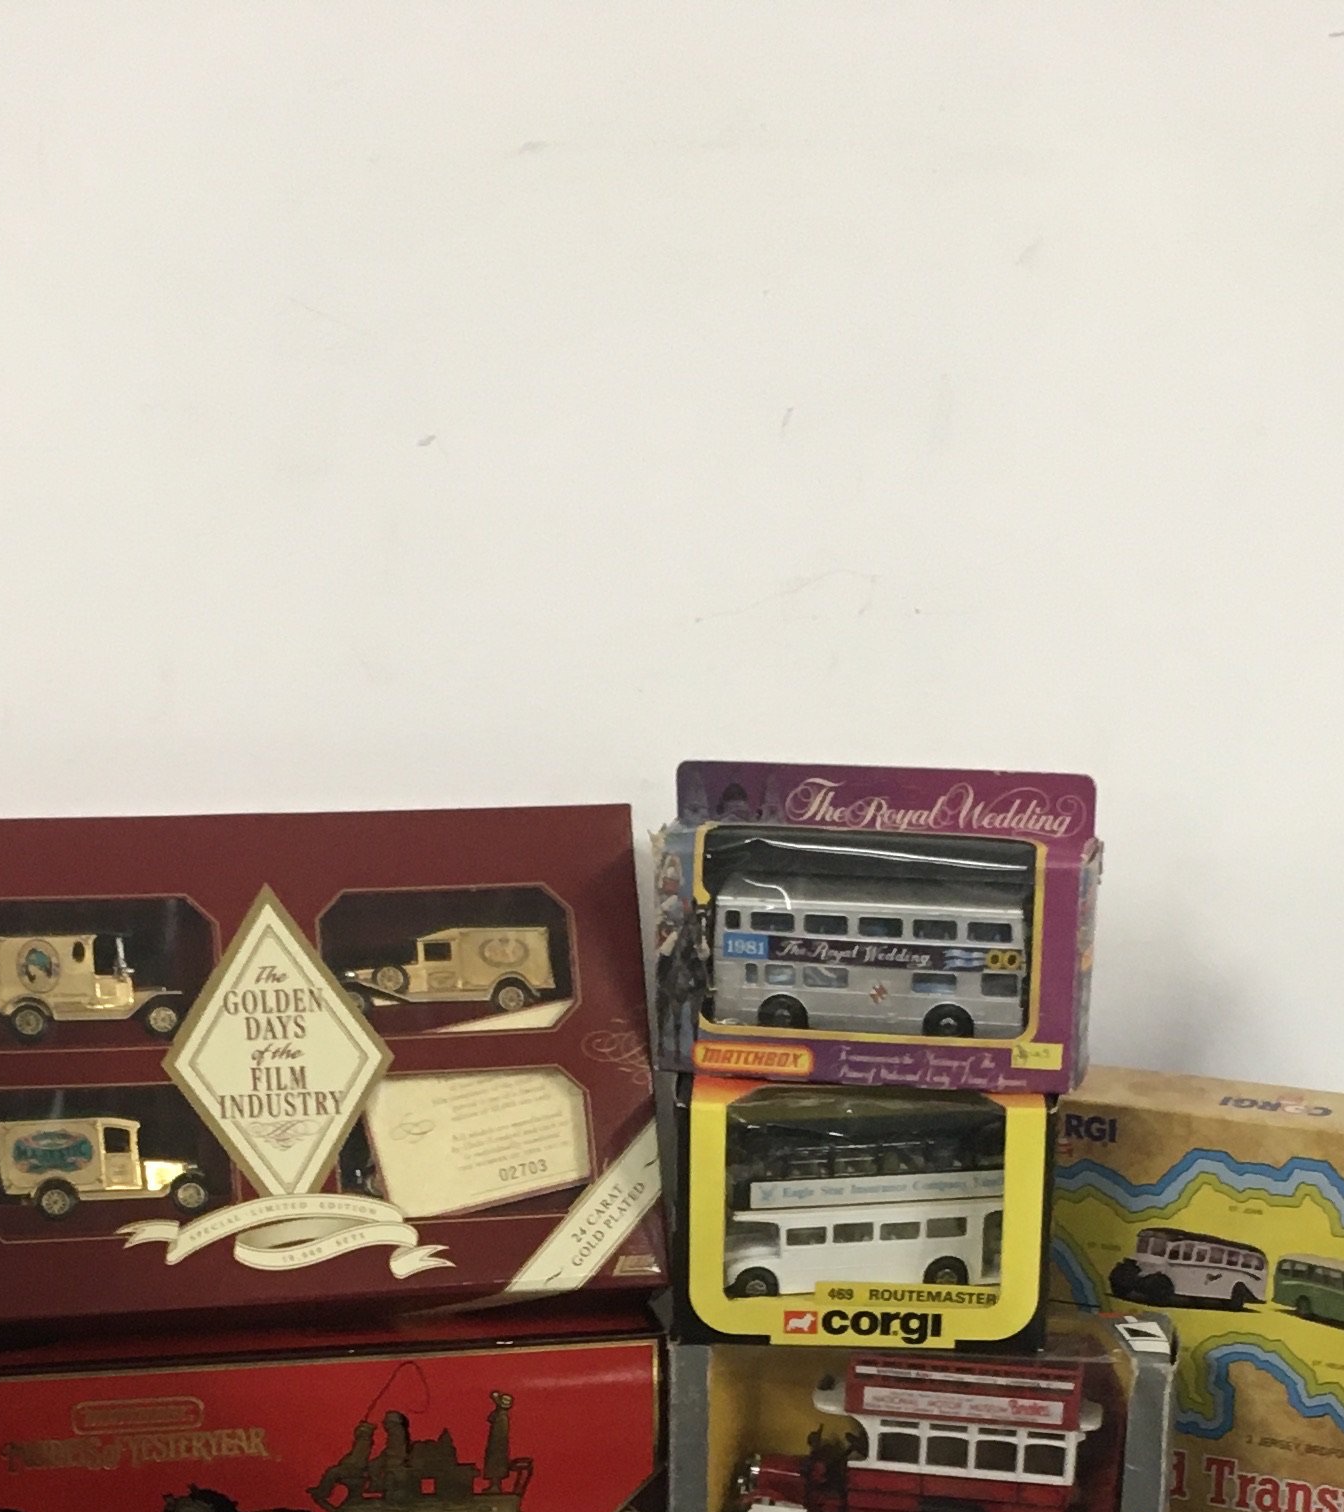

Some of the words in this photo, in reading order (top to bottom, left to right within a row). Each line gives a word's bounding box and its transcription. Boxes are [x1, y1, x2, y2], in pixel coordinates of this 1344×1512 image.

[786, 777, 850, 825] The
[849, 796, 944, 831] Royal
[950, 783, 1086, 837] Wedding
[726, 938, 765, 956] 1981
[777, 940, 801, 958] The
[812, 941, 859, 964] Royal
[863, 942, 931, 969] Wedding
[256, 965, 288, 986] The
[223, 987, 325, 1015] GOLDEN
[244, 1016, 307, 1041] DAYS
[251, 1044, 272, 1062] of
[272, 1042, 304, 1061] the
[701, 1045, 806, 1069] MATCHBOX
[251, 1065, 308, 1091] FILM
[218, 1091, 345, 1120] INDUSTRY
[1218, 1095, 1334, 1118] CORGI
[1064, 1111, 1119, 1144] RGI
[498, 1159, 548, 1182] 02703
[250, 1200, 308, 1217] LIMITED
[319, 1200, 377, 1216] EDITION
[571, 1226, 587, 1243] 24
[586, 1182, 623, 1226] CARAT
[571, 1229, 605, 1267] GOLD
[603, 1181, 646, 1230] PLATED
[868, 1287, 998, 1306] ROUTEMASTER
[821, 1310, 944, 1345] corgi
